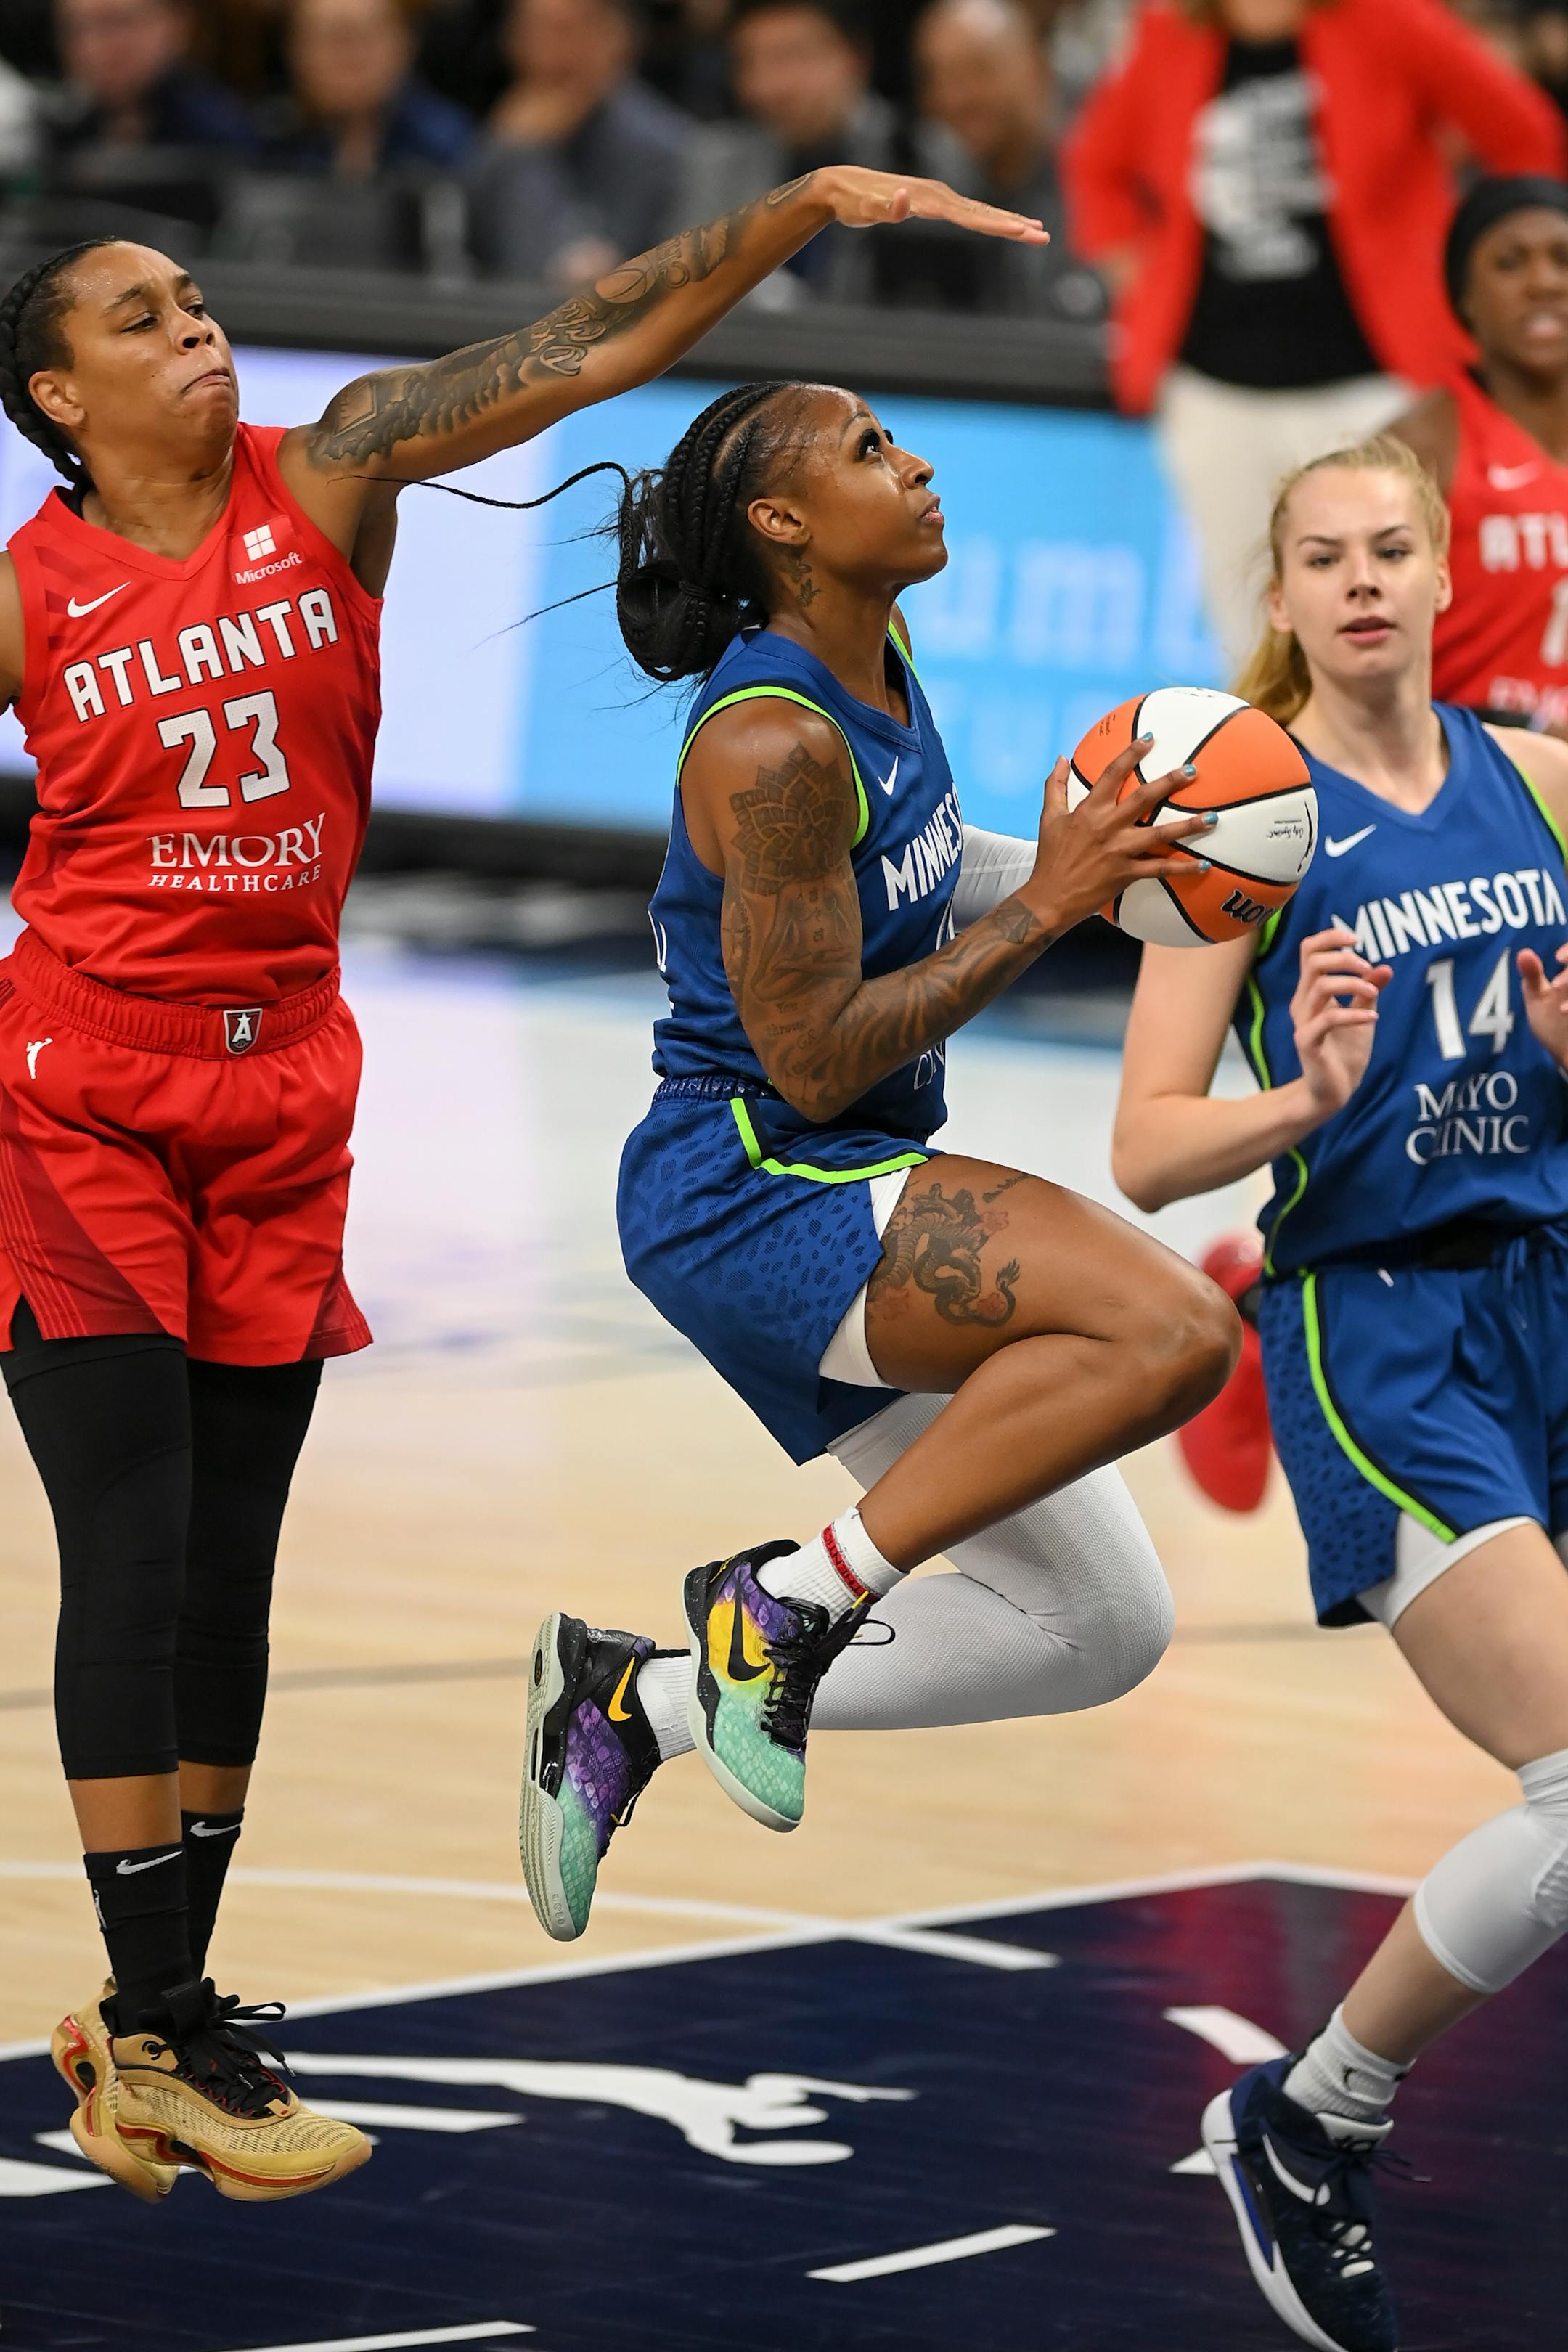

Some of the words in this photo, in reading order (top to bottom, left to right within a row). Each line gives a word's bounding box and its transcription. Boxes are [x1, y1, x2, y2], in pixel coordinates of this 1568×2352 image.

[234, 552, 303, 584] Microsoft
[63, 588, 339, 723] ATLANTA
[156, 690, 290, 809] 23
[145, 812, 325, 868] EMORY
[147, 864, 322, 892] HEALTHCARE
[1331, 868, 1567, 964] MINNESOTA
[1426, 947, 1514, 1061] 14
